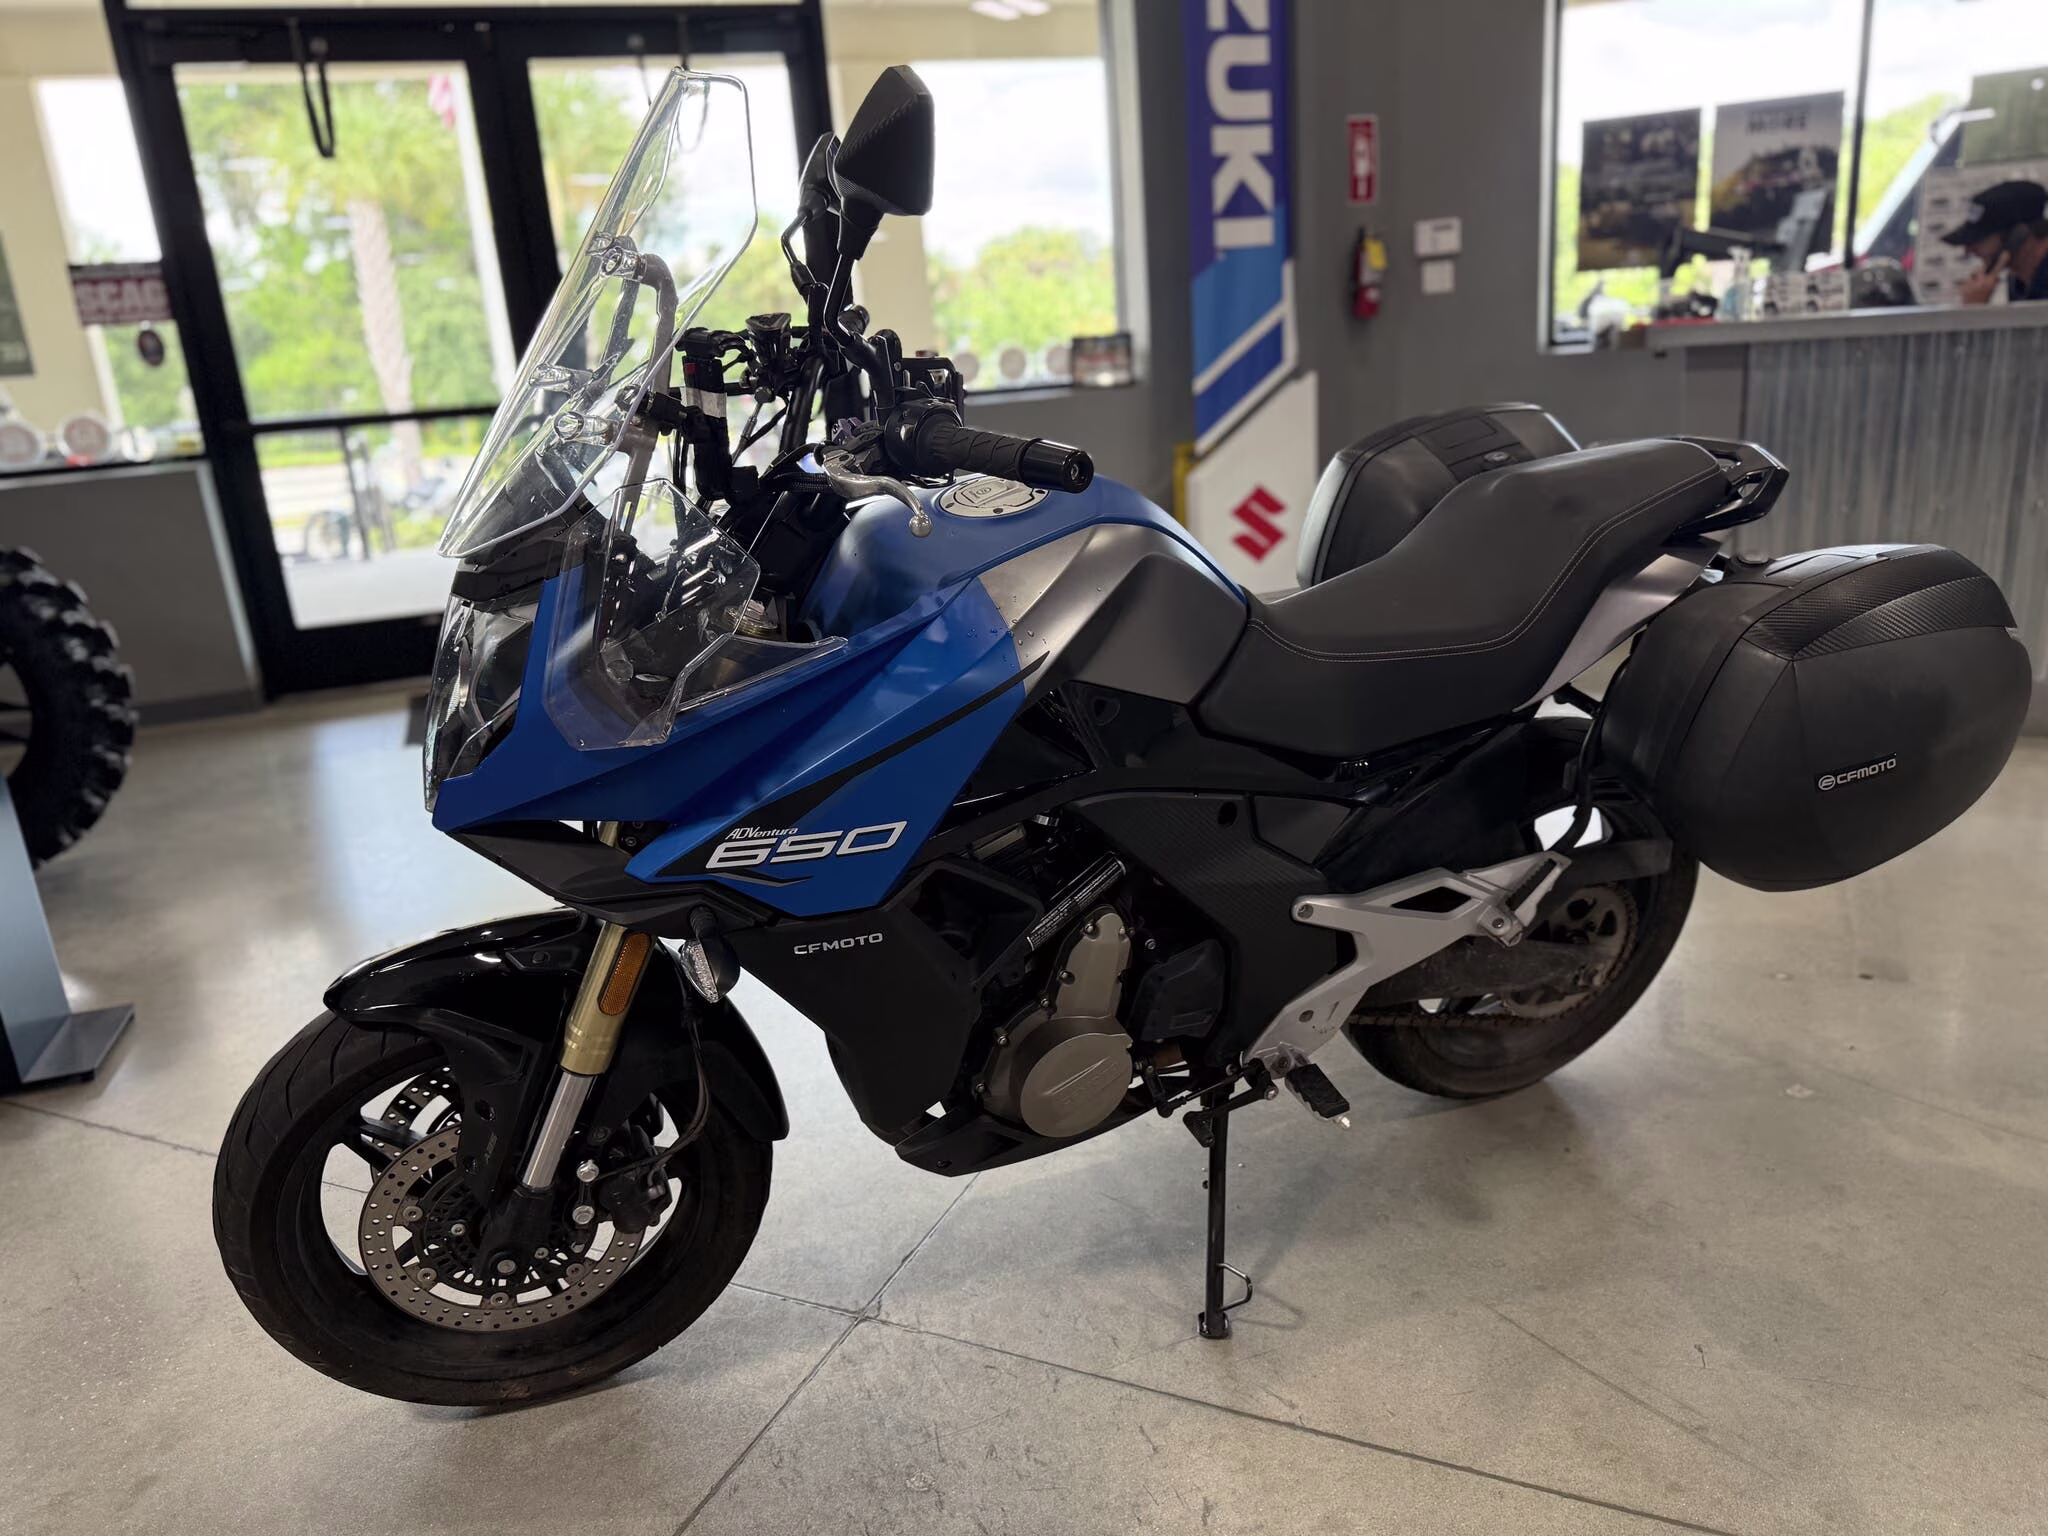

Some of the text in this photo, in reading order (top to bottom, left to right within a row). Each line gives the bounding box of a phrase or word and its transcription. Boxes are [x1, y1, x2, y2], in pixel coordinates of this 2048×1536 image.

[1836, 758, 1897, 785] CFMOTO
[706, 821, 907, 869] 650
[725, 827, 798, 840] ADVentura
[794, 932, 884, 955] CFMOTO
